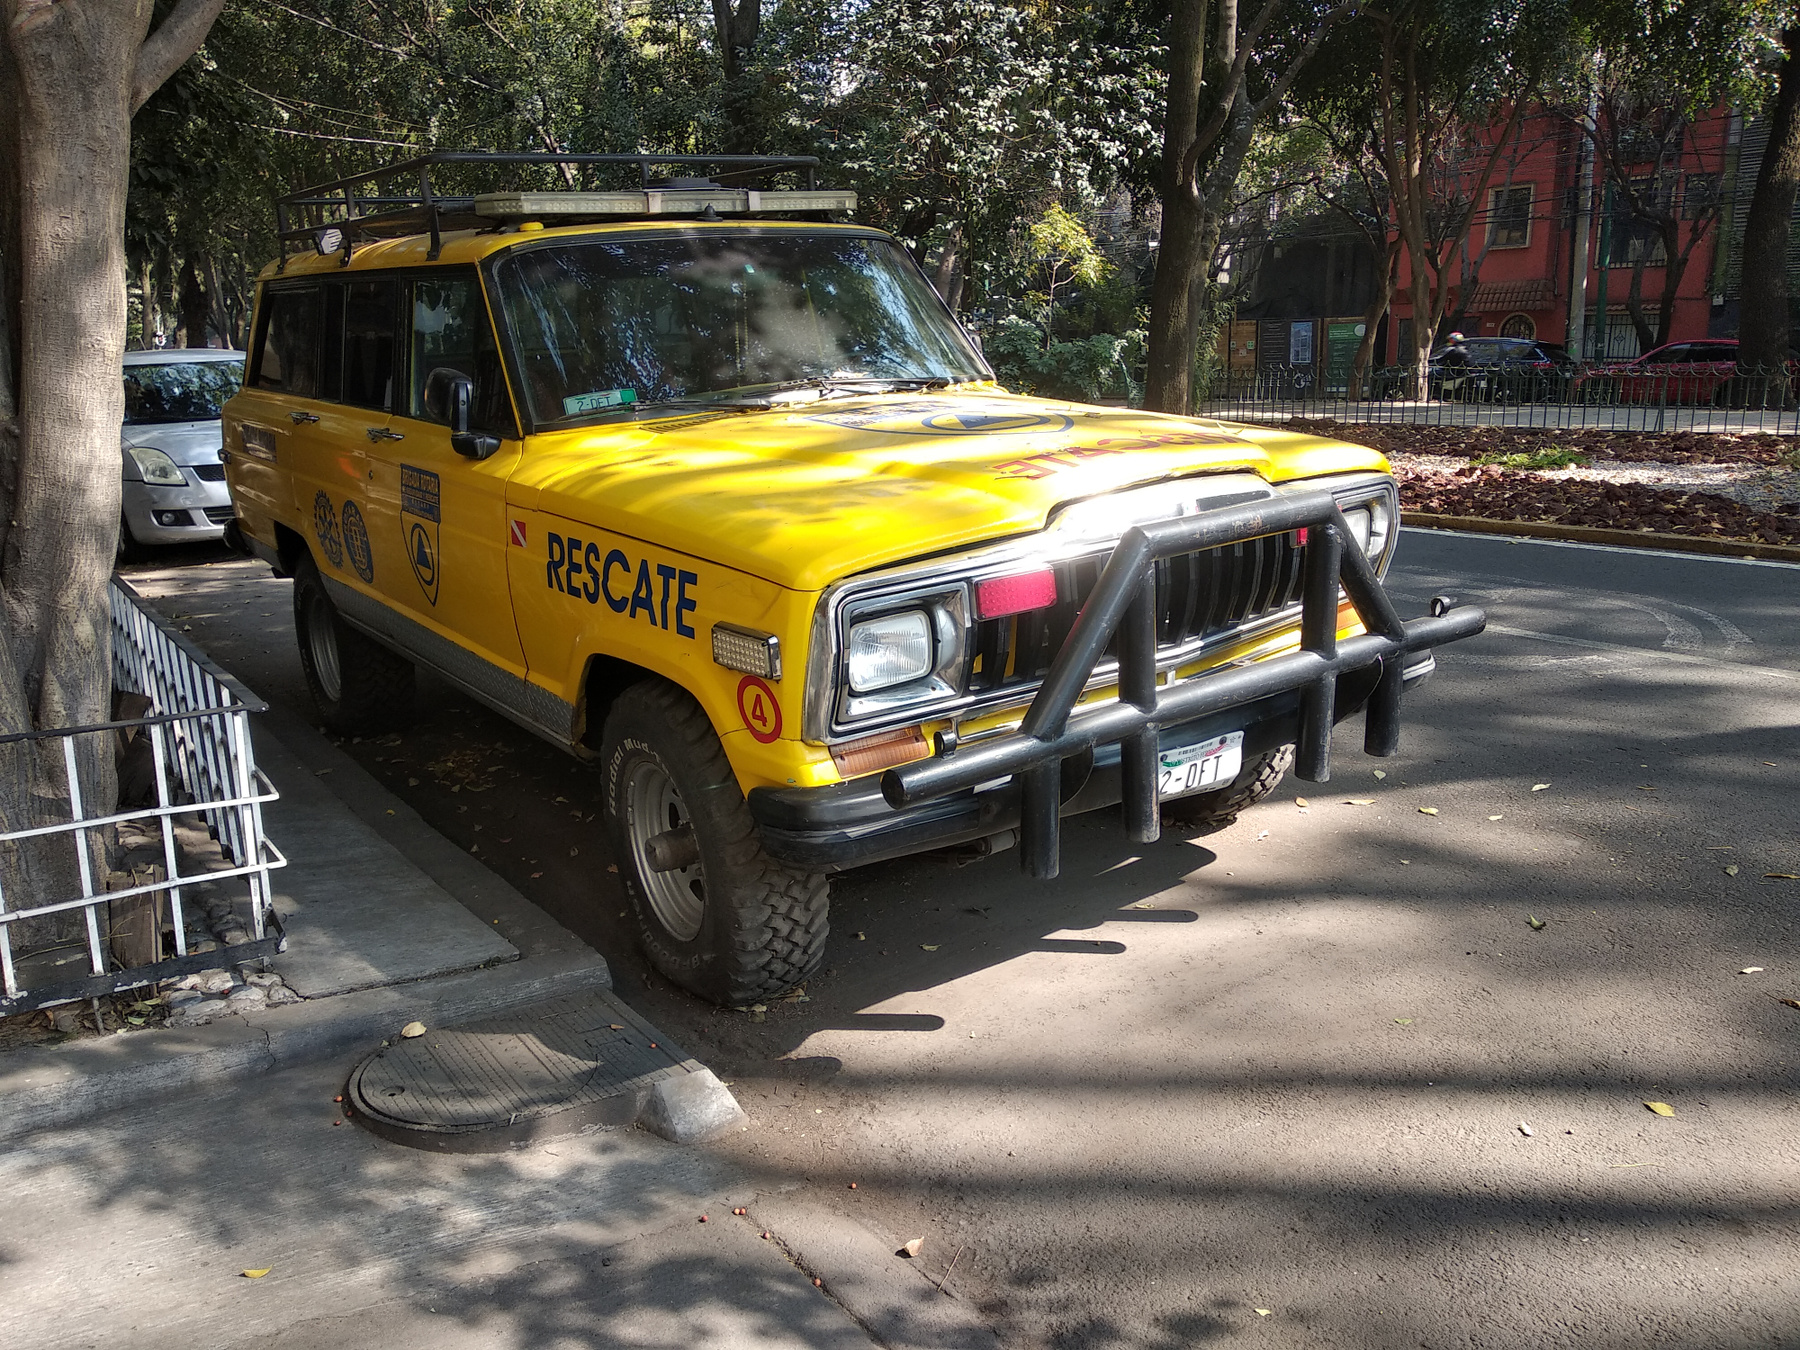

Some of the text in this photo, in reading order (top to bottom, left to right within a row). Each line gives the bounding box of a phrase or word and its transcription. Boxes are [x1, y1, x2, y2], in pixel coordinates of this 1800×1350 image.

[547, 531, 698, 639] RESCATE
[751, 693, 768, 728] 4
[608, 745, 624, 816] Radial
[1159, 754, 1223, 795] 2-DFT
